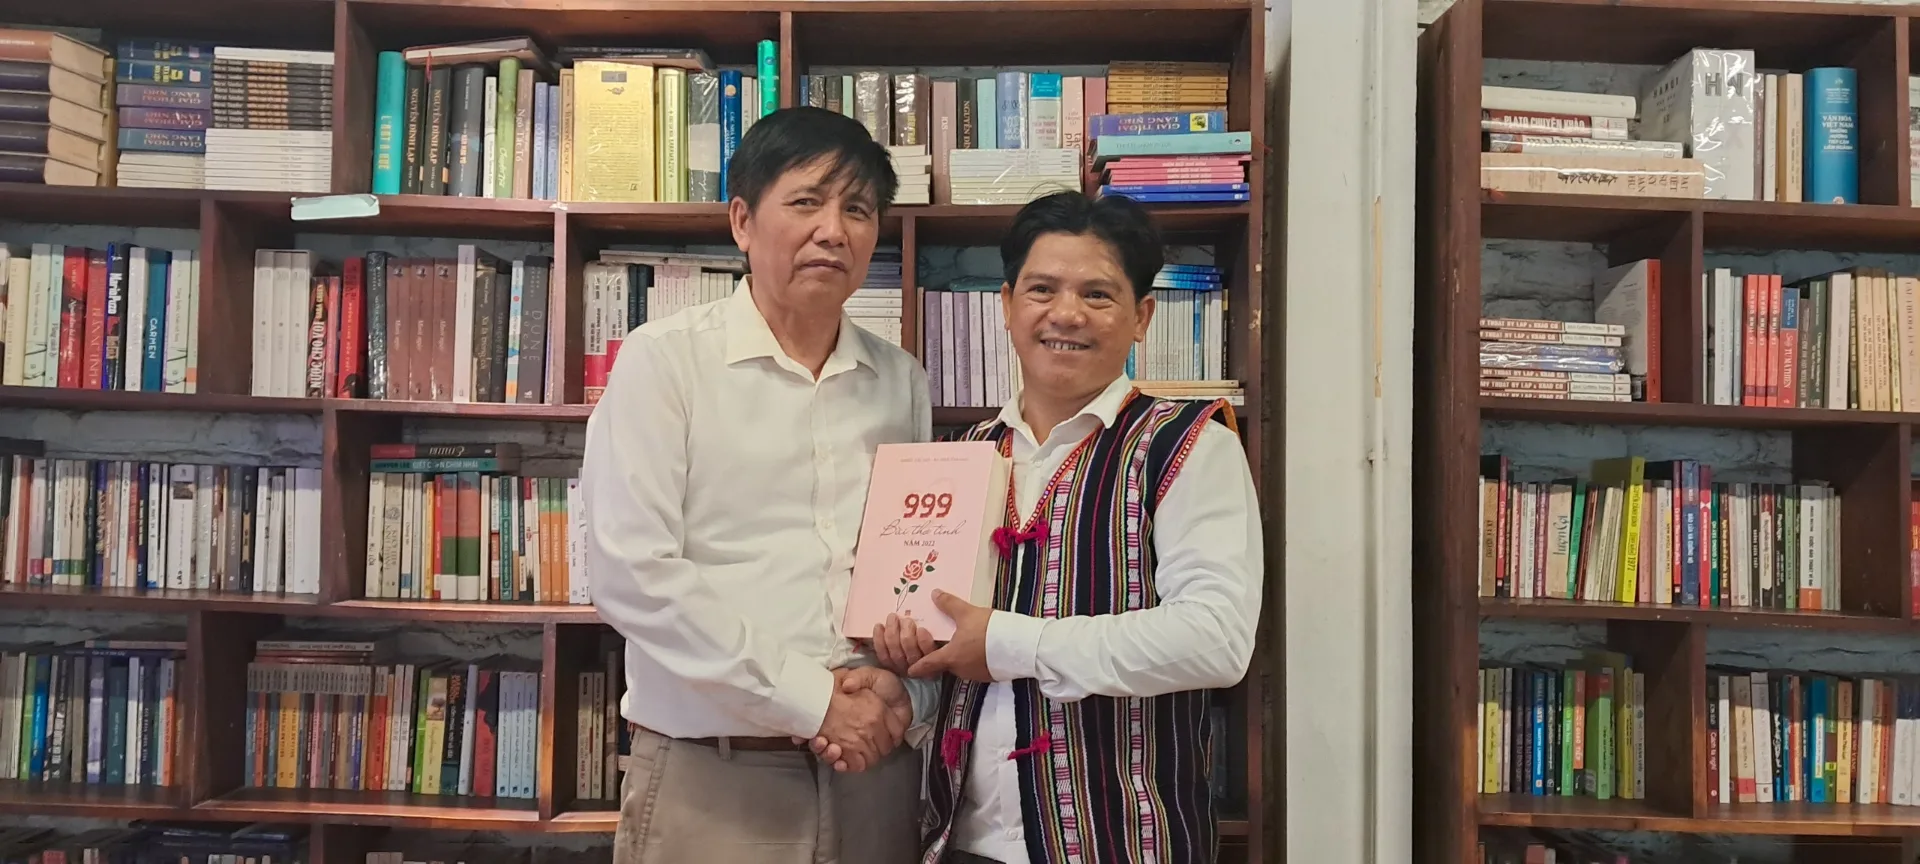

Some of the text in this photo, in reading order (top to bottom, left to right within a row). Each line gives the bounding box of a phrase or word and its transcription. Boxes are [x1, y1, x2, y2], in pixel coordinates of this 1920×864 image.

[963, 136, 971, 149] ĐÌN
[148, 318, 158, 359] CARMEN
[312, 321, 325, 339] VOI
[311, 340, 324, 360] CHO
[903, 492, 953, 519] 999
[880, 519, 909, 538] Bài
